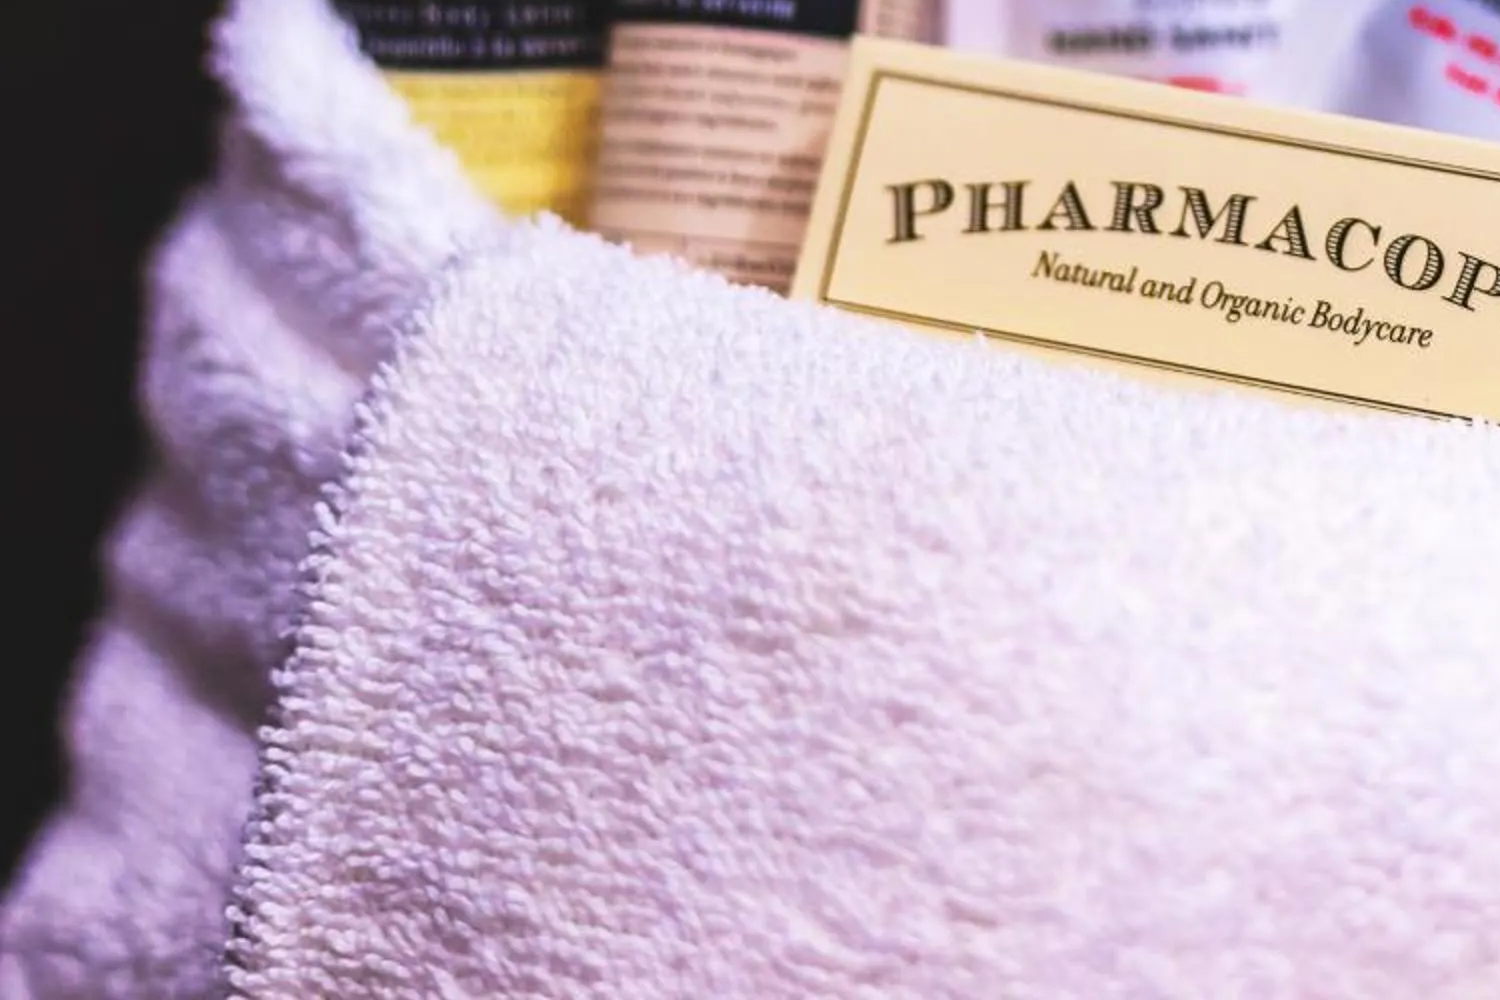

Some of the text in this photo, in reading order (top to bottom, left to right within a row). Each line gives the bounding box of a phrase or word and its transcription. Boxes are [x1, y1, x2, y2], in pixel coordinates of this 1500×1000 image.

[1030, 250, 1436, 348] Natural and Organic Bodycare
